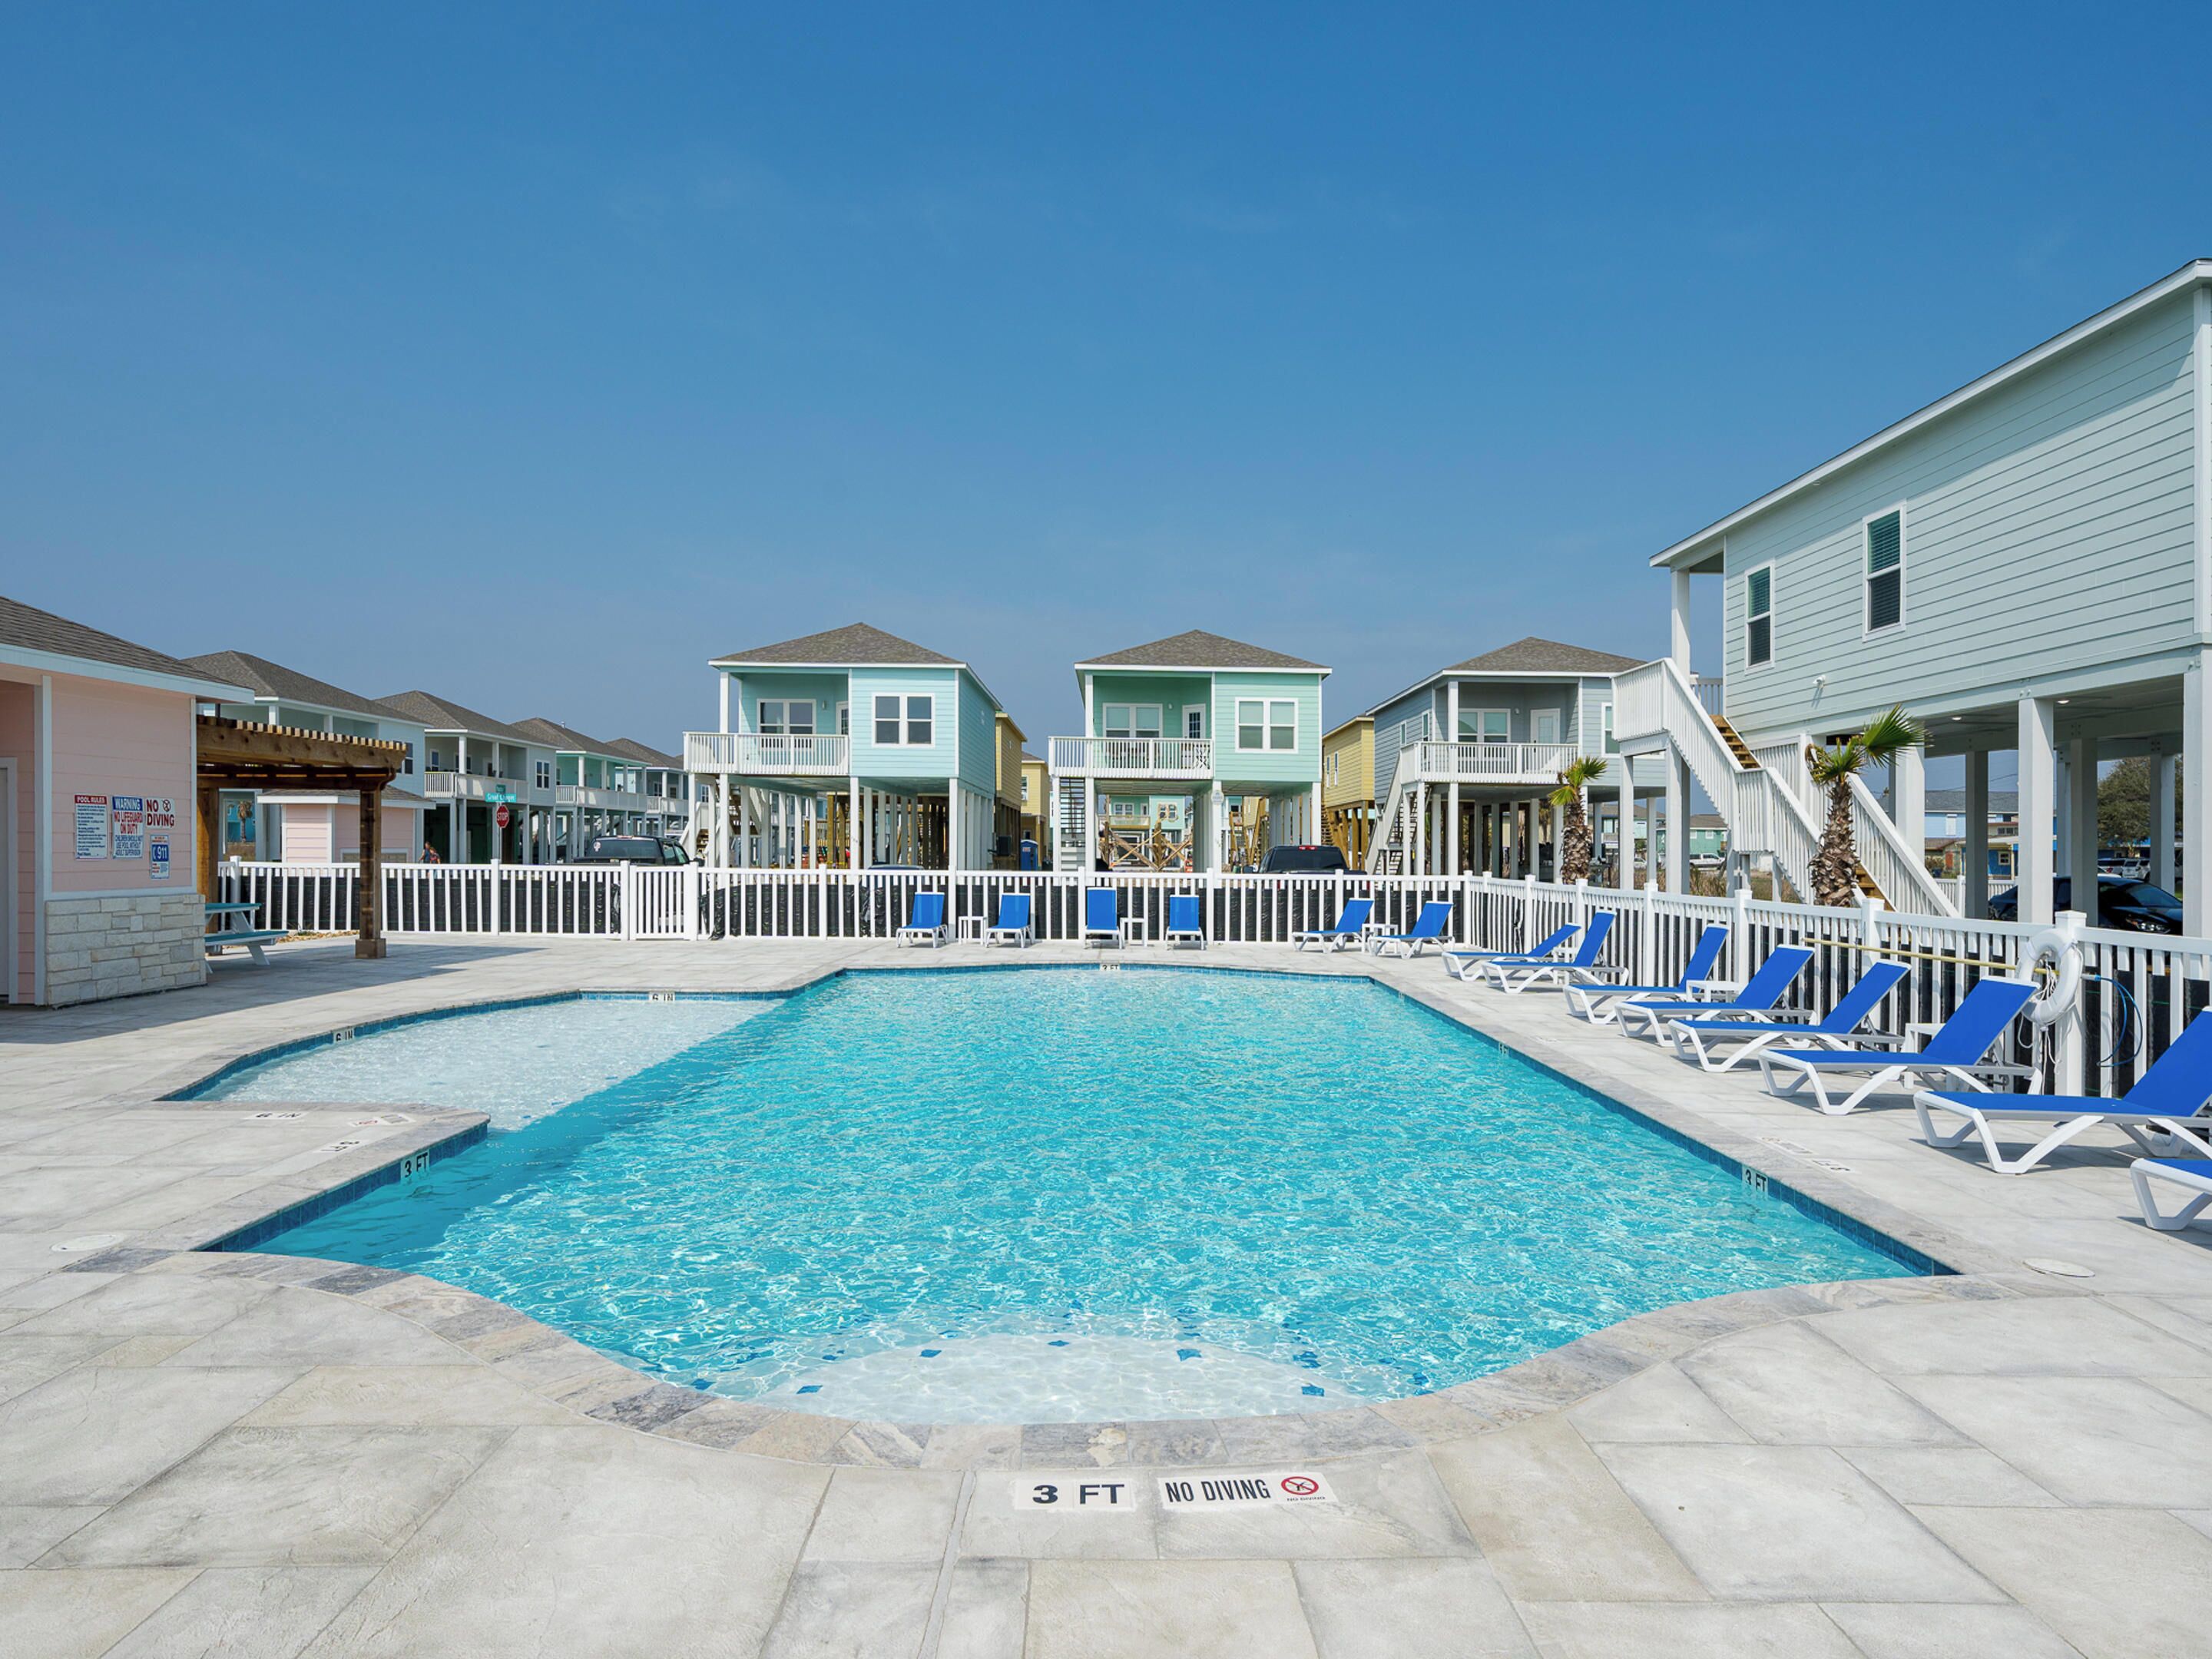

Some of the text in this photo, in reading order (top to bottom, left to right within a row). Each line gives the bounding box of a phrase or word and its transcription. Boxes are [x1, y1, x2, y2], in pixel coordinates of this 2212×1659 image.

[114, 797, 141, 810] WARNING
[146, 799, 159, 812] NO
[114, 811, 120, 823] NO
[121, 811, 143, 823] LIFEGUARD
[147, 813, 174, 827] DIVING
[497, 812, 508, 821] STOP
[120, 823, 138, 834] ON DUTY
[157, 846, 167, 859] 911
[404, 1152, 429, 1177] 3 FT
[1746, 1169, 1767, 1192] 3 FT
[1032, 1484, 1124, 1504] 3 FT
[1165, 1479, 1271, 1502] NO DIVING
